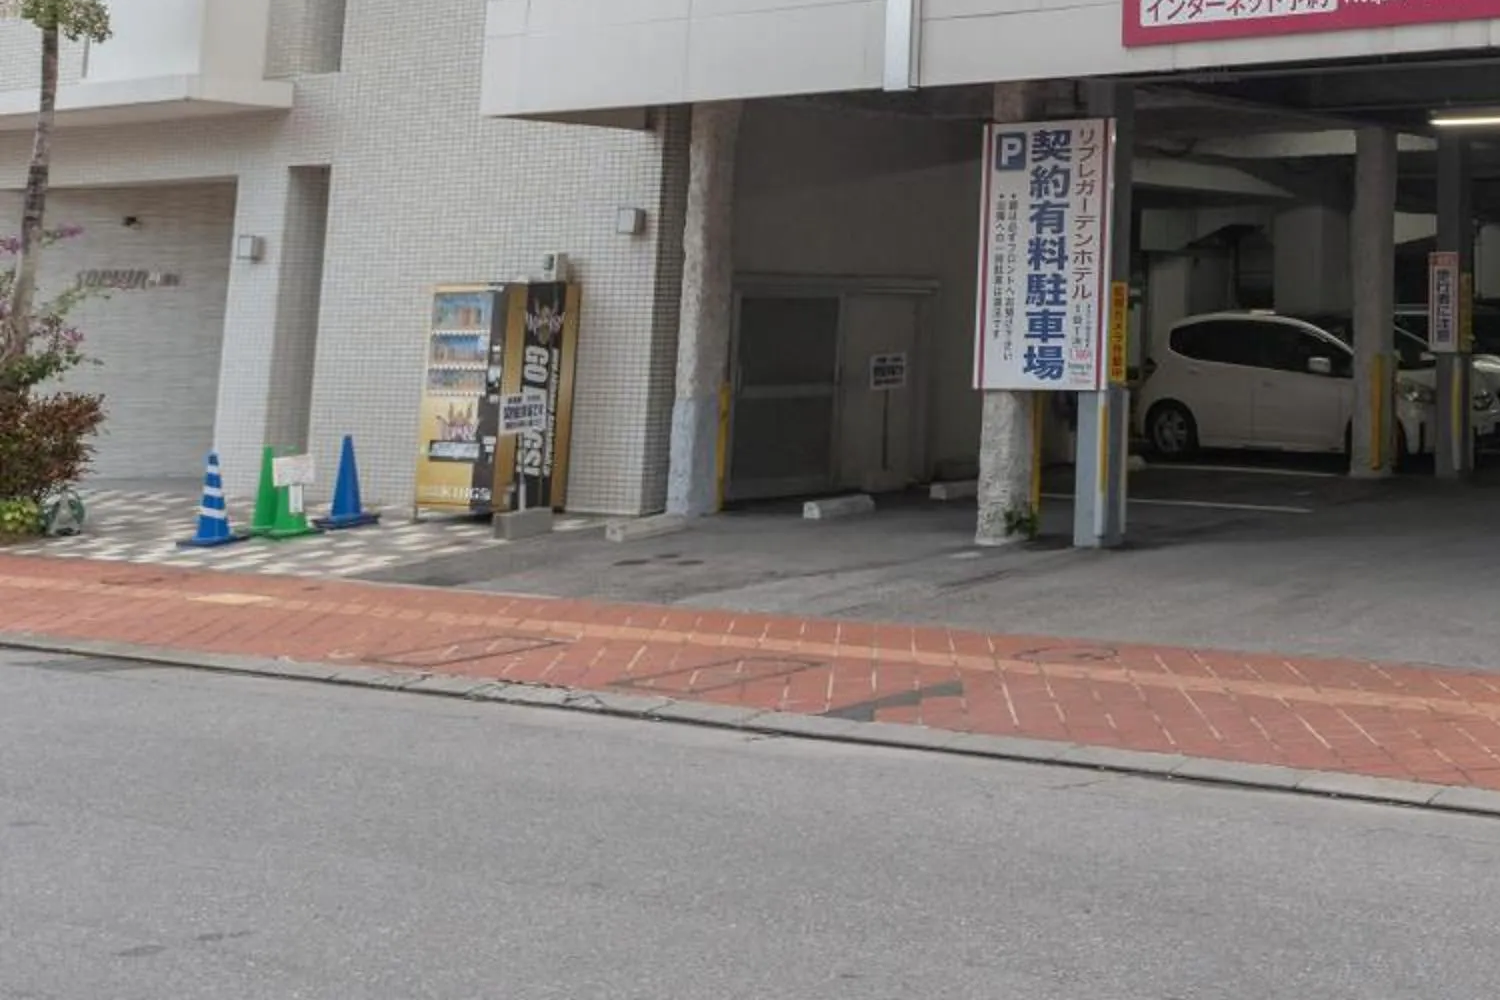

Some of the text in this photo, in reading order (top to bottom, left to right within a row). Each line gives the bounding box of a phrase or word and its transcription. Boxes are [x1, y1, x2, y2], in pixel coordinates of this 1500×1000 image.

[1001, 137, 1023, 164] P
[1072, 128, 1097, 300] リブレガーデンホテル
[1023, 128, 1072, 381] 契約有料駐車場
